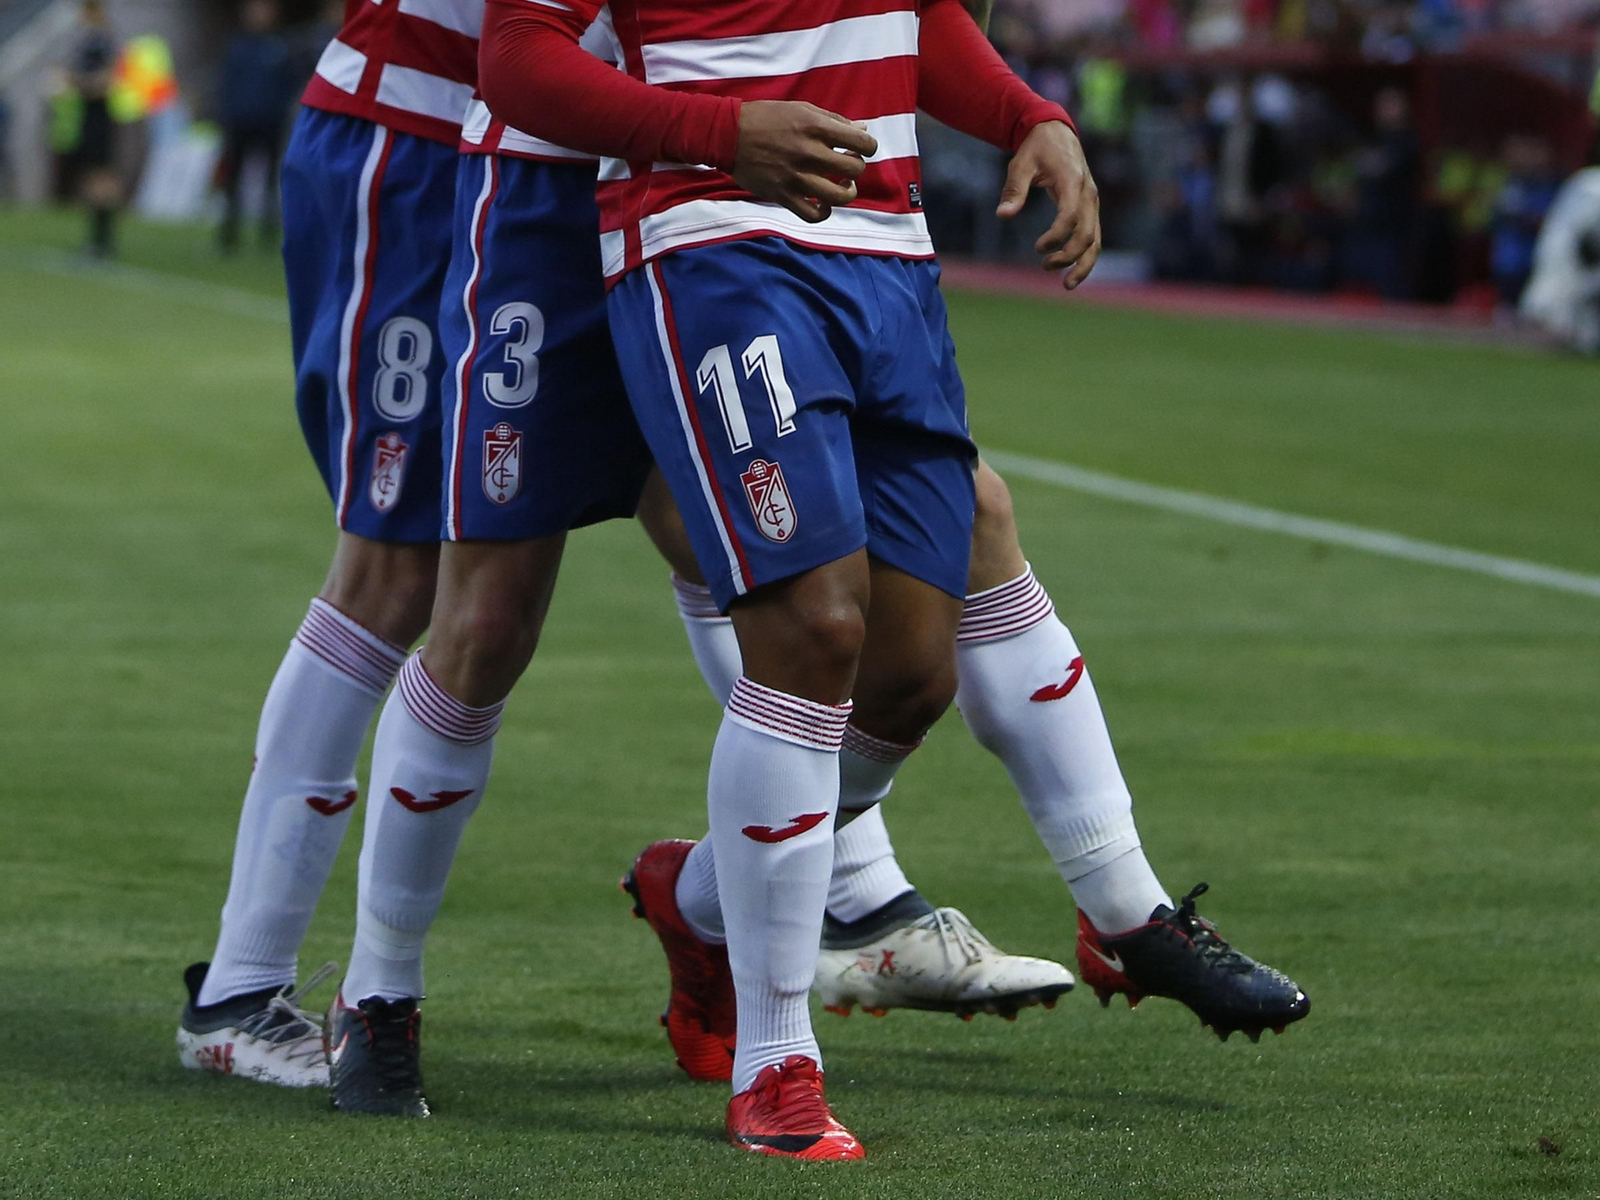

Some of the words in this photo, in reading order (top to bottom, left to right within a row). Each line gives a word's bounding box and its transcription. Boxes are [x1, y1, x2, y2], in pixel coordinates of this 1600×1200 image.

[372, 316, 433, 422] 8
[482, 301, 546, 409] 3
[695, 333, 798, 455] 11
